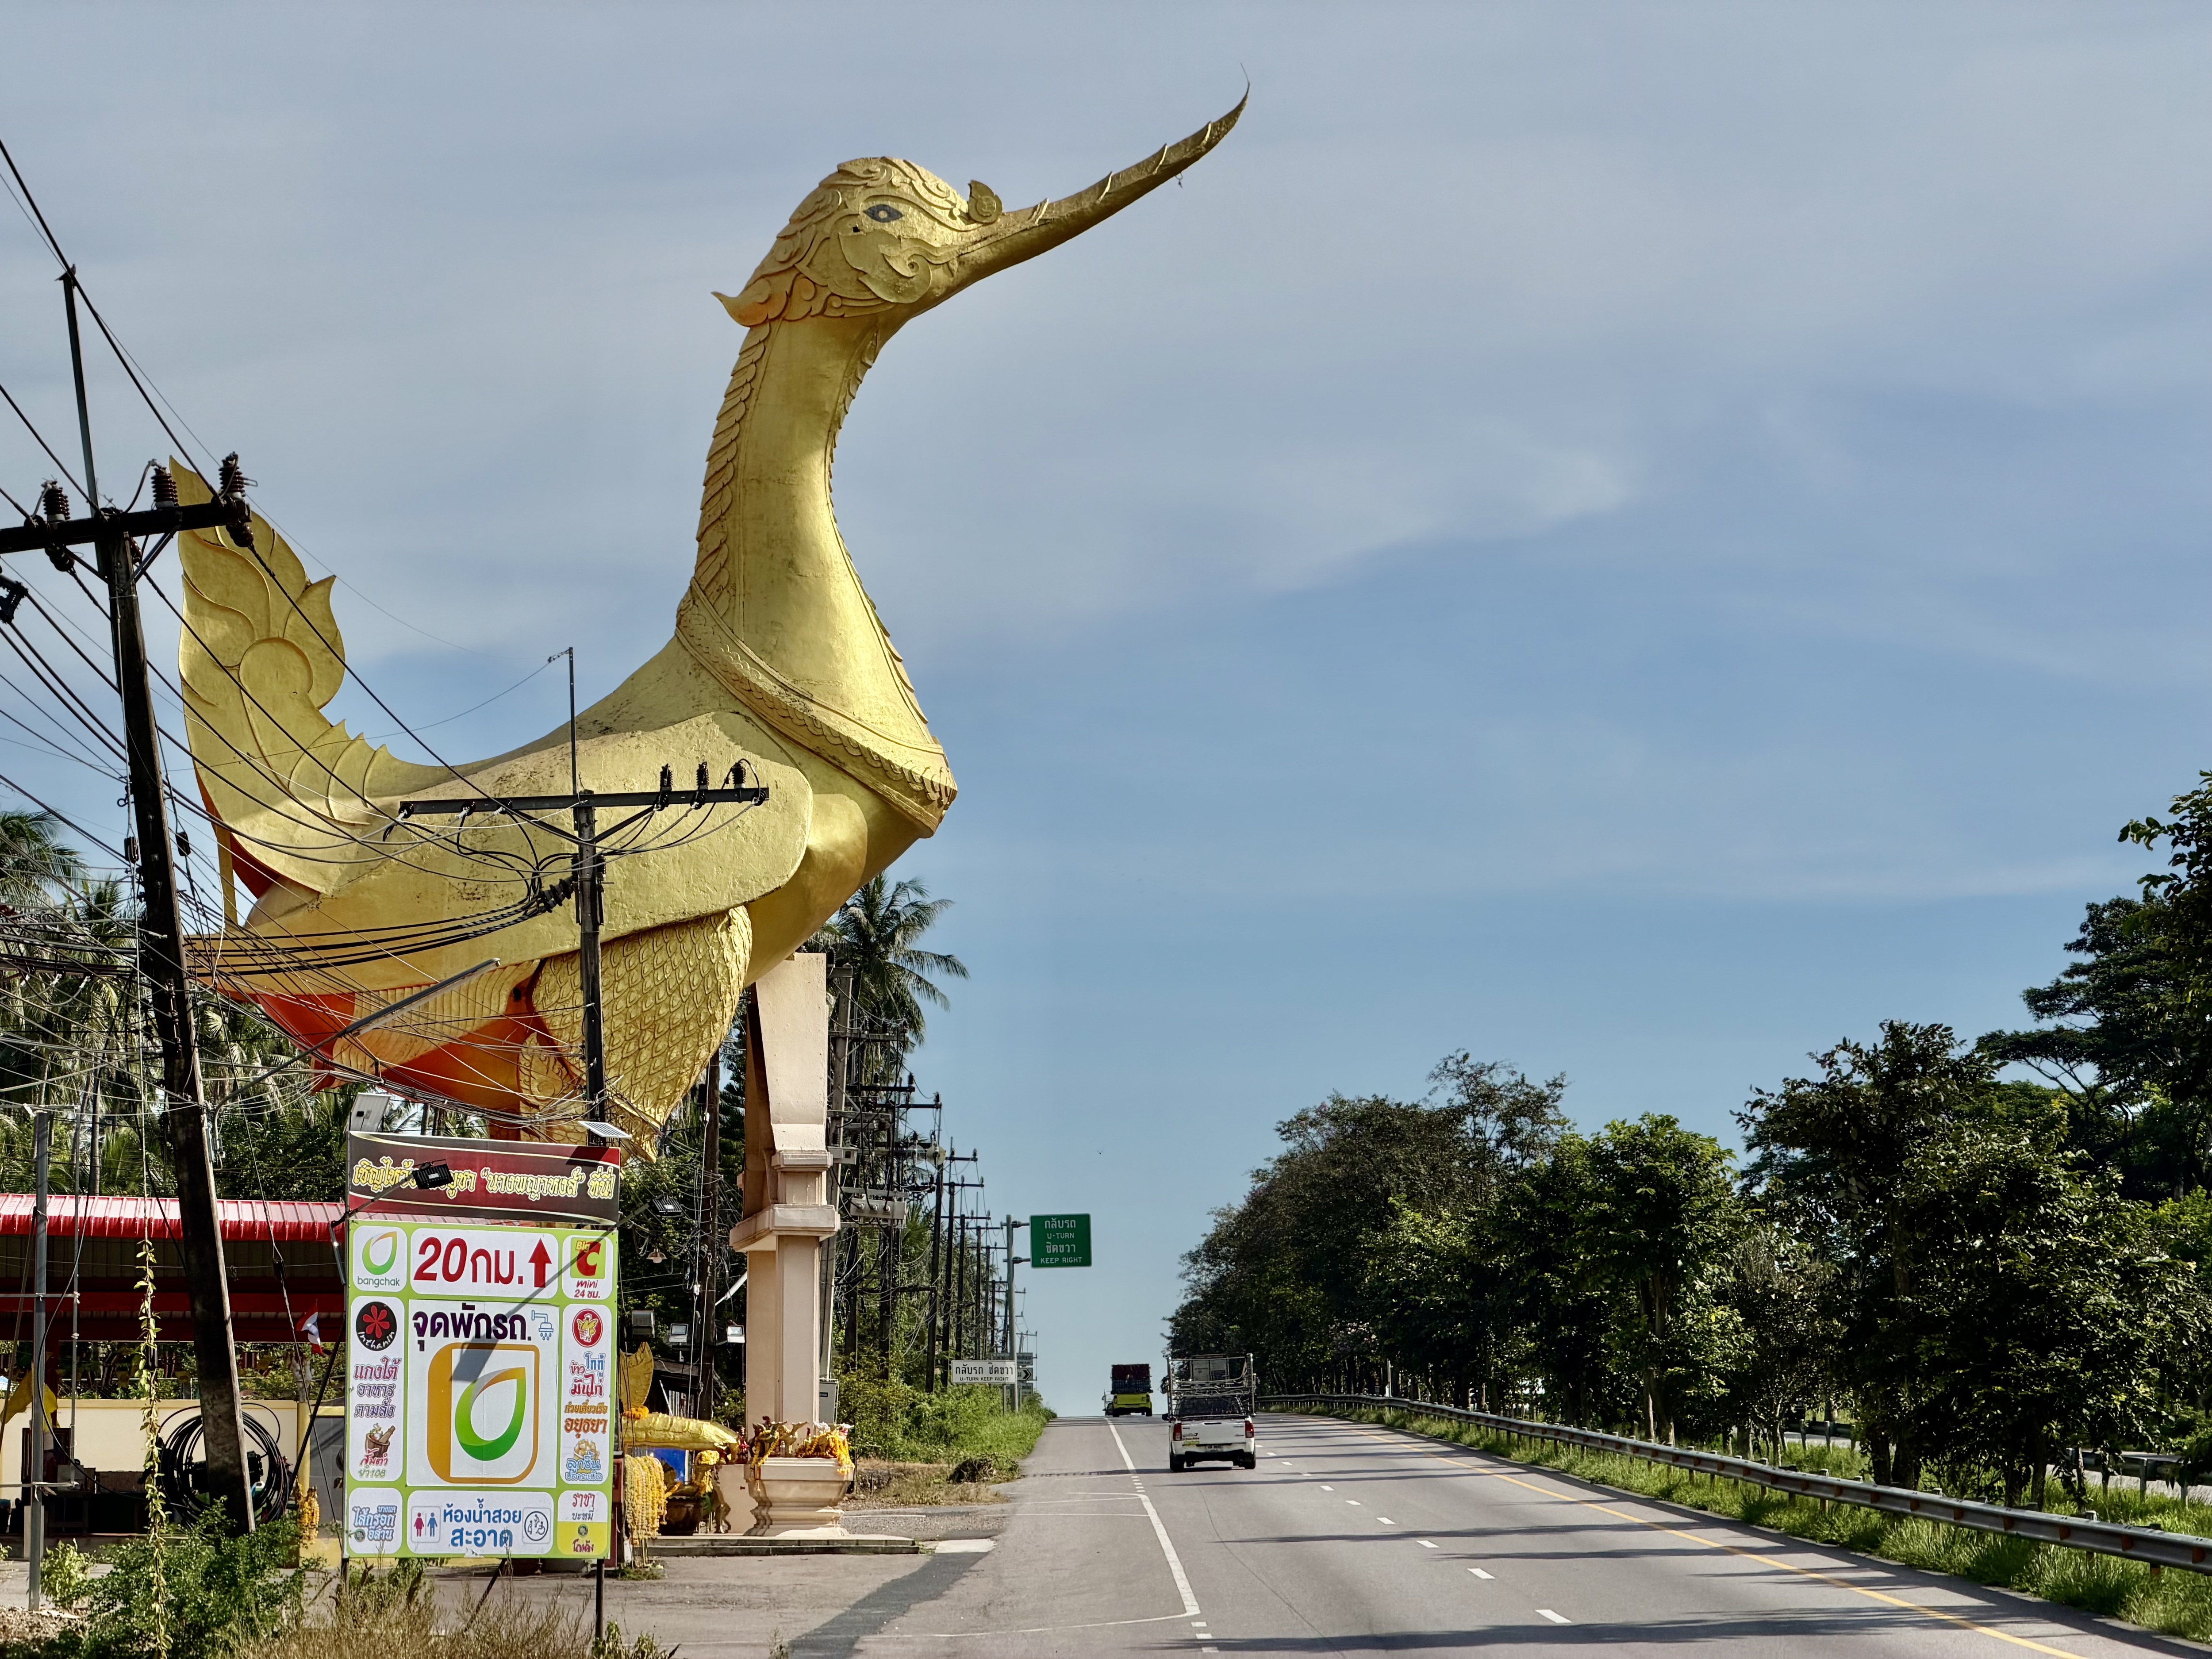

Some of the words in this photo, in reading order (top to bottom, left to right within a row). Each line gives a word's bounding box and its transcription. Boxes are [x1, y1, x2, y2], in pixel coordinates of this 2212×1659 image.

[1045, 1217, 1076, 1229] กลับรถ
[1046, 1241, 1076, 1253] ชิดขวา
[357, 1276, 400, 1288] bangchak
[576, 1280, 599, 1288] mini
[574, 1289, 585, 1298] 24
[358, 1332, 395, 1349] Inthanin
[354, 1356, 401, 1380] แกงใต้
[570, 1361, 585, 1375] ข้าว
[956, 1364, 983, 1375] กลับรถ
[988, 1362, 1013, 1375] ชิดขวา
[357, 1384, 396, 1398] อาหาร
[570, 1374, 603, 1397] มันไก่
[354, 1398, 395, 1417] ตามสั่ง
[564, 1418, 608, 1438] อยุธยา
[360, 1448, 388, 1466] ส้มตำ
[567, 1451, 601, 1473] ลูกชิ้น
[565, 1470, 603, 1481] ปลาระเบิด
[353, 1506, 396, 1528] ไส้กรอก
[443, 1498, 521, 1524] ห้องน้ำสวย
[368, 1526, 394, 1541] อีสาน
[450, 1527, 513, 1548] สะอาด
